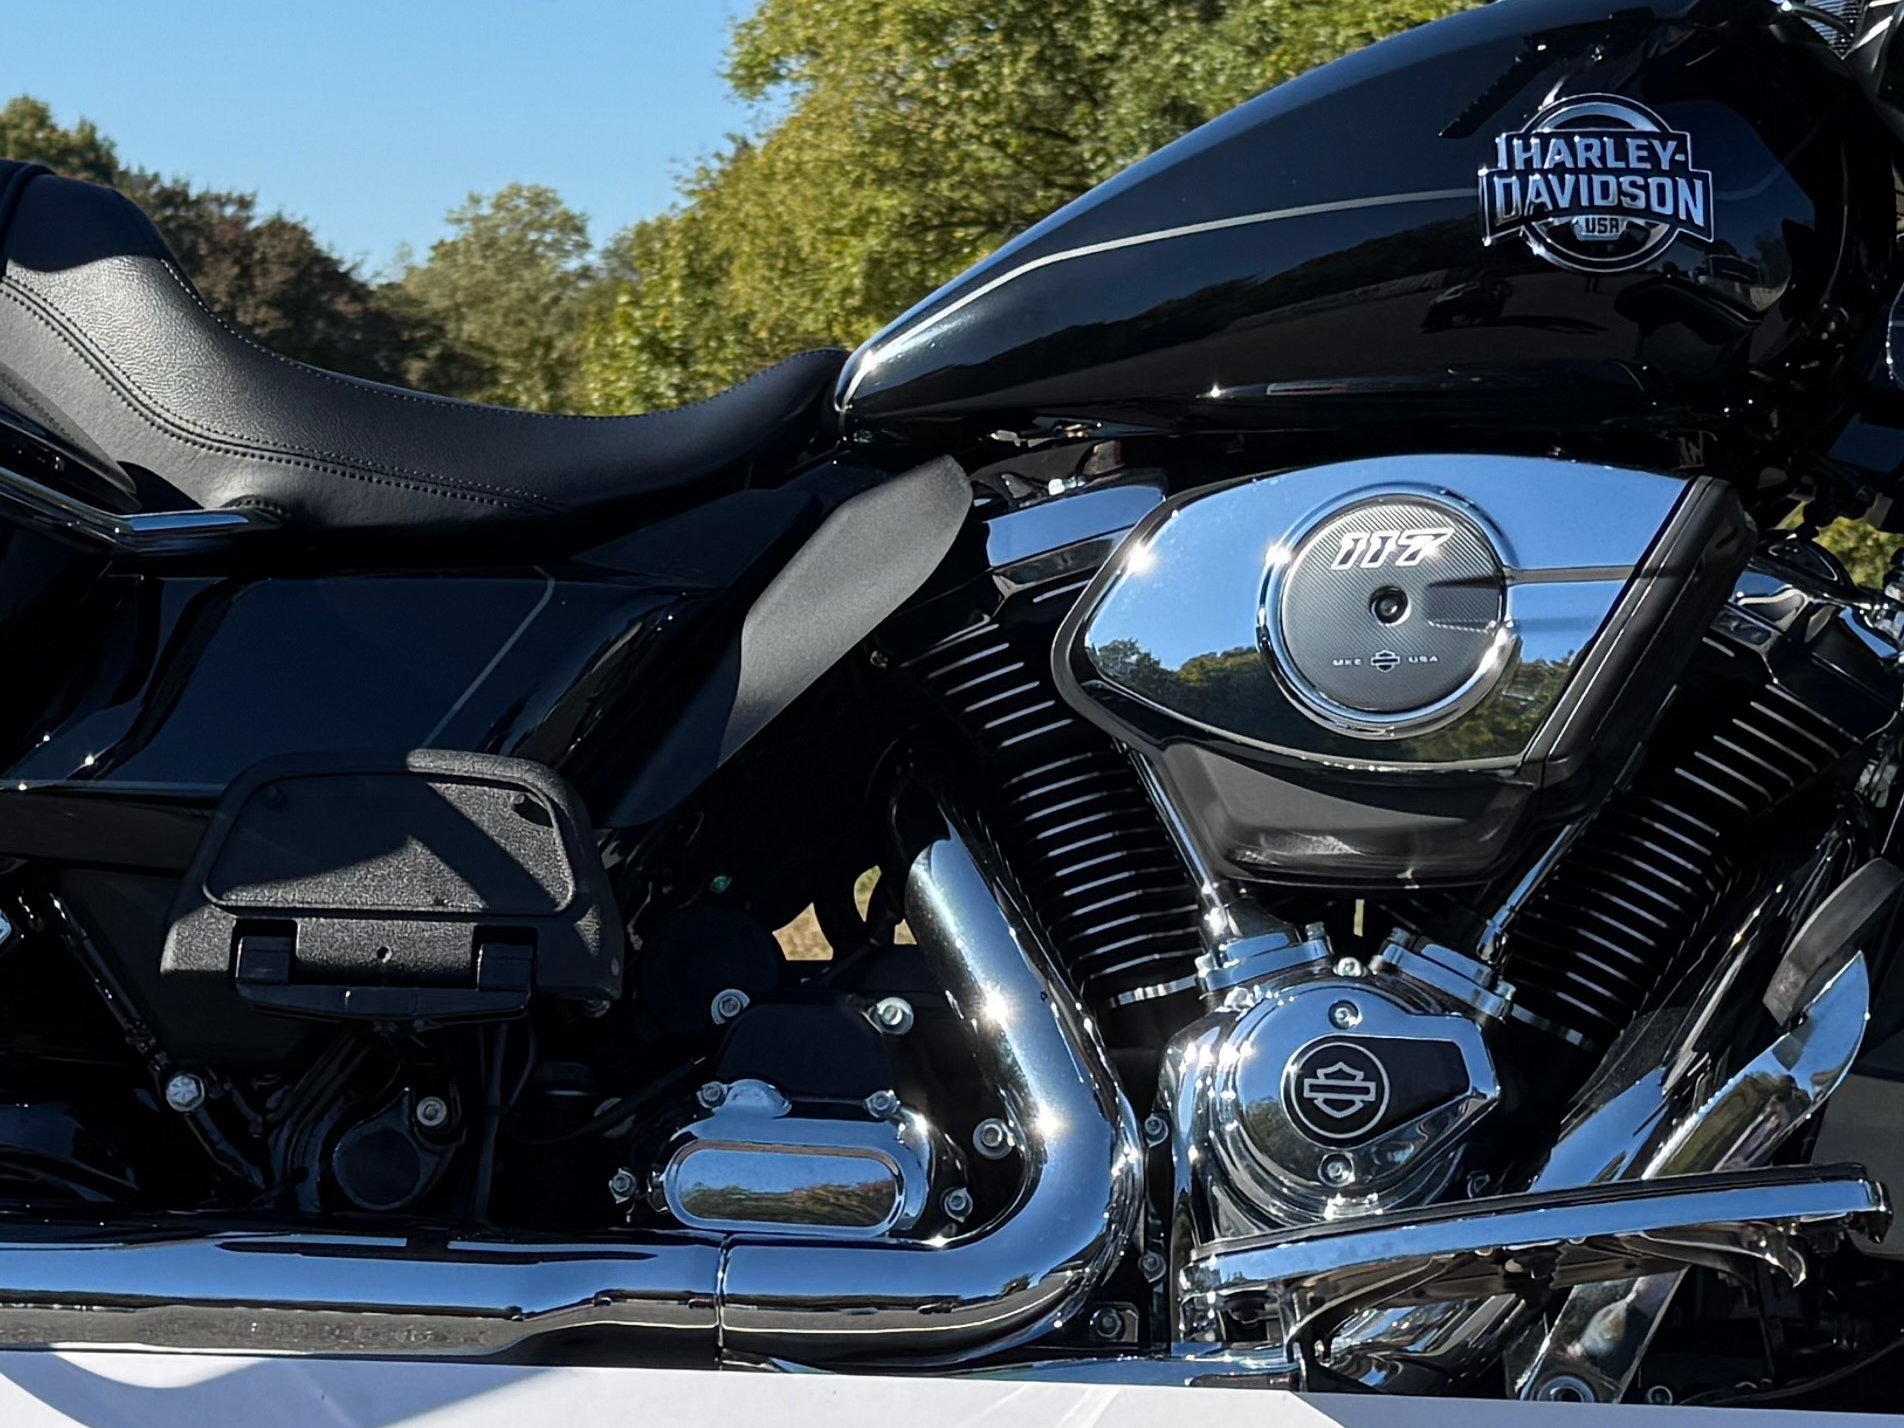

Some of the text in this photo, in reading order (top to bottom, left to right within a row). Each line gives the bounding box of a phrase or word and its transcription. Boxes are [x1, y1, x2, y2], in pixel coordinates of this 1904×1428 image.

[1512, 134, 1686, 172] HARLEY-
[1492, 172, 1705, 228] DAVIDSON
[1584, 217, 1621, 235] USA
[1407, 655, 1439, 664] USA
